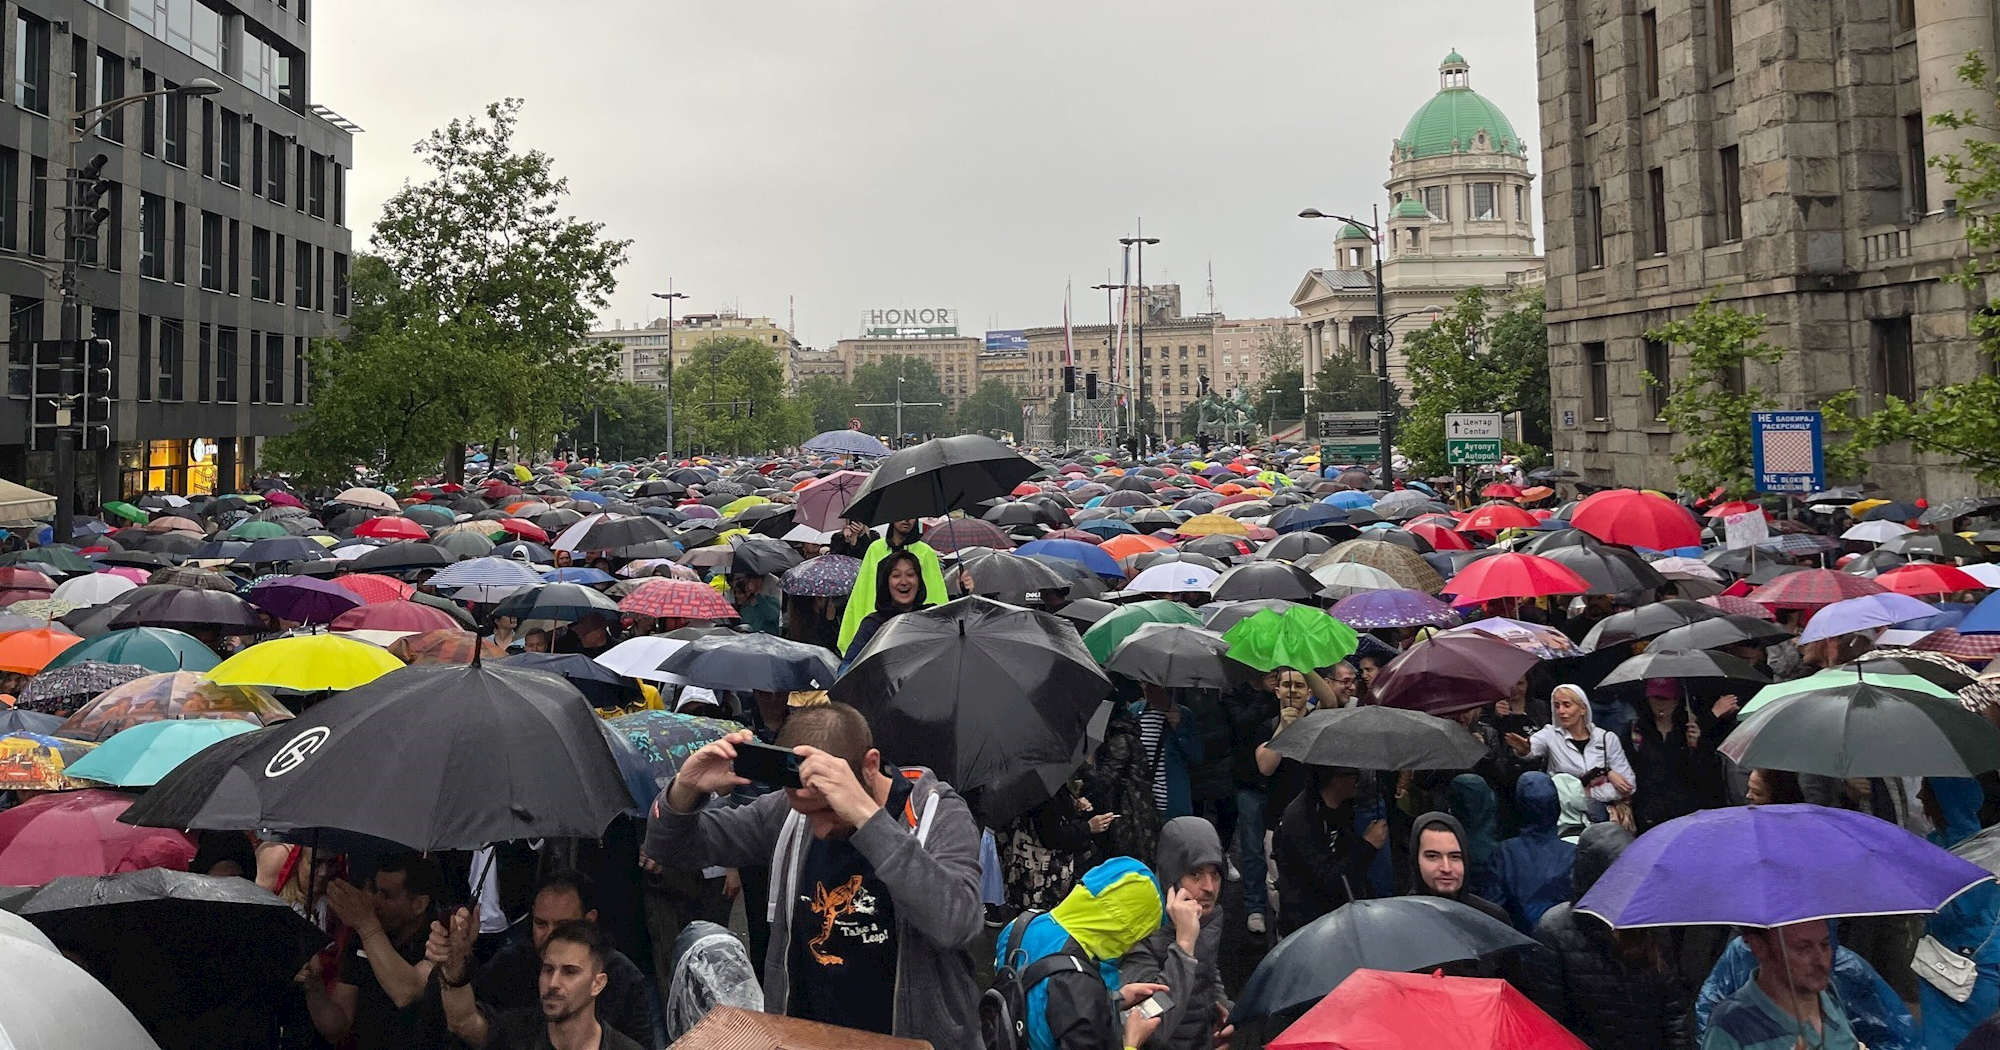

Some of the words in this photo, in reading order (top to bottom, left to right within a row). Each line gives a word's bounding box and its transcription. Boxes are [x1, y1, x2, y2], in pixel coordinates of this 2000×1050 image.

[871, 308, 949, 324] HONOR
[1463, 418, 1492, 427] Центар
[1758, 414, 1772, 422] НЕ
[1464, 442, 1496, 451] Аутопут
[1464, 452, 1495, 461] Autoput
[1763, 474, 1777, 483] NE
[840, 926, 869, 936] Take
[871, 923, 878, 931] a
[862, 930, 888, 944] Leap!
